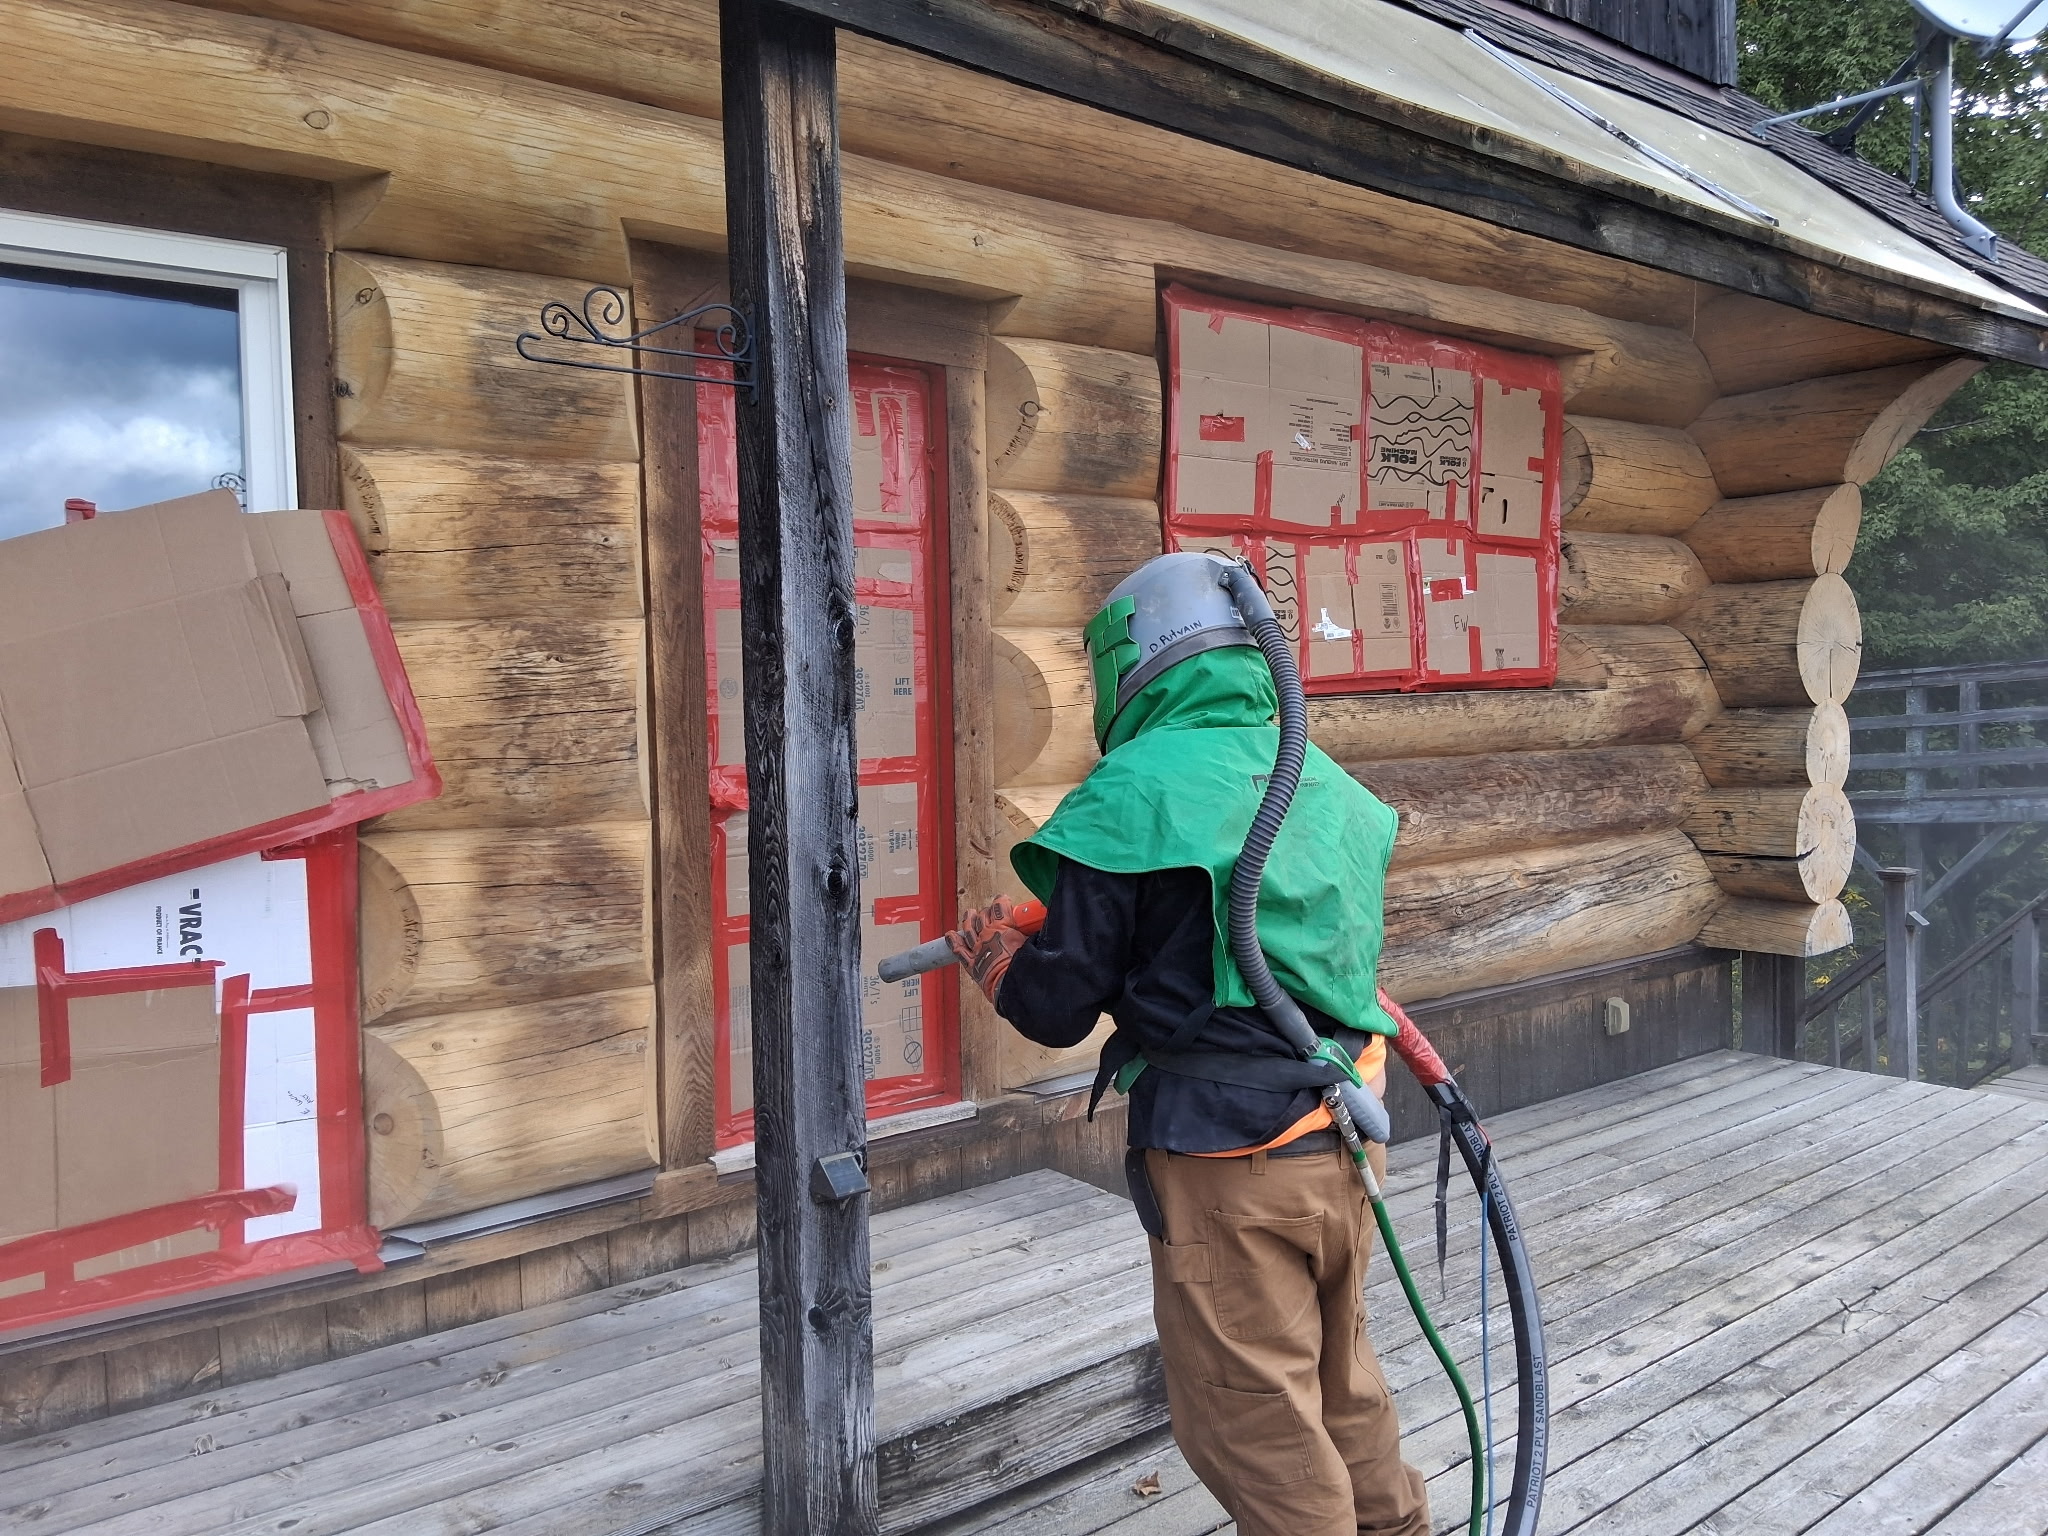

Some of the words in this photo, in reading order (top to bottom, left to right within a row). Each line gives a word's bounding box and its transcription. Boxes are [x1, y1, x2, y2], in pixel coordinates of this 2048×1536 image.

[1381, 447, 1417, 455] MACHINE
[1381, 453, 1417, 465] FOLK
[1439, 459, 1461, 467] FOLK
[179, 903, 203, 956] VRAC
[902, 978, 919, 987] HERE
[904, 988, 918, 997] LIFT
[1487, 1172, 1500, 1190] PLY
[1499, 1199, 1518, 1241] PATRIOT
[1533, 1354, 1545, 1420] SANDBLAST
[1535, 1428, 1544, 1448] PLY
[1527, 1461, 1541, 1508] PATRIOT
